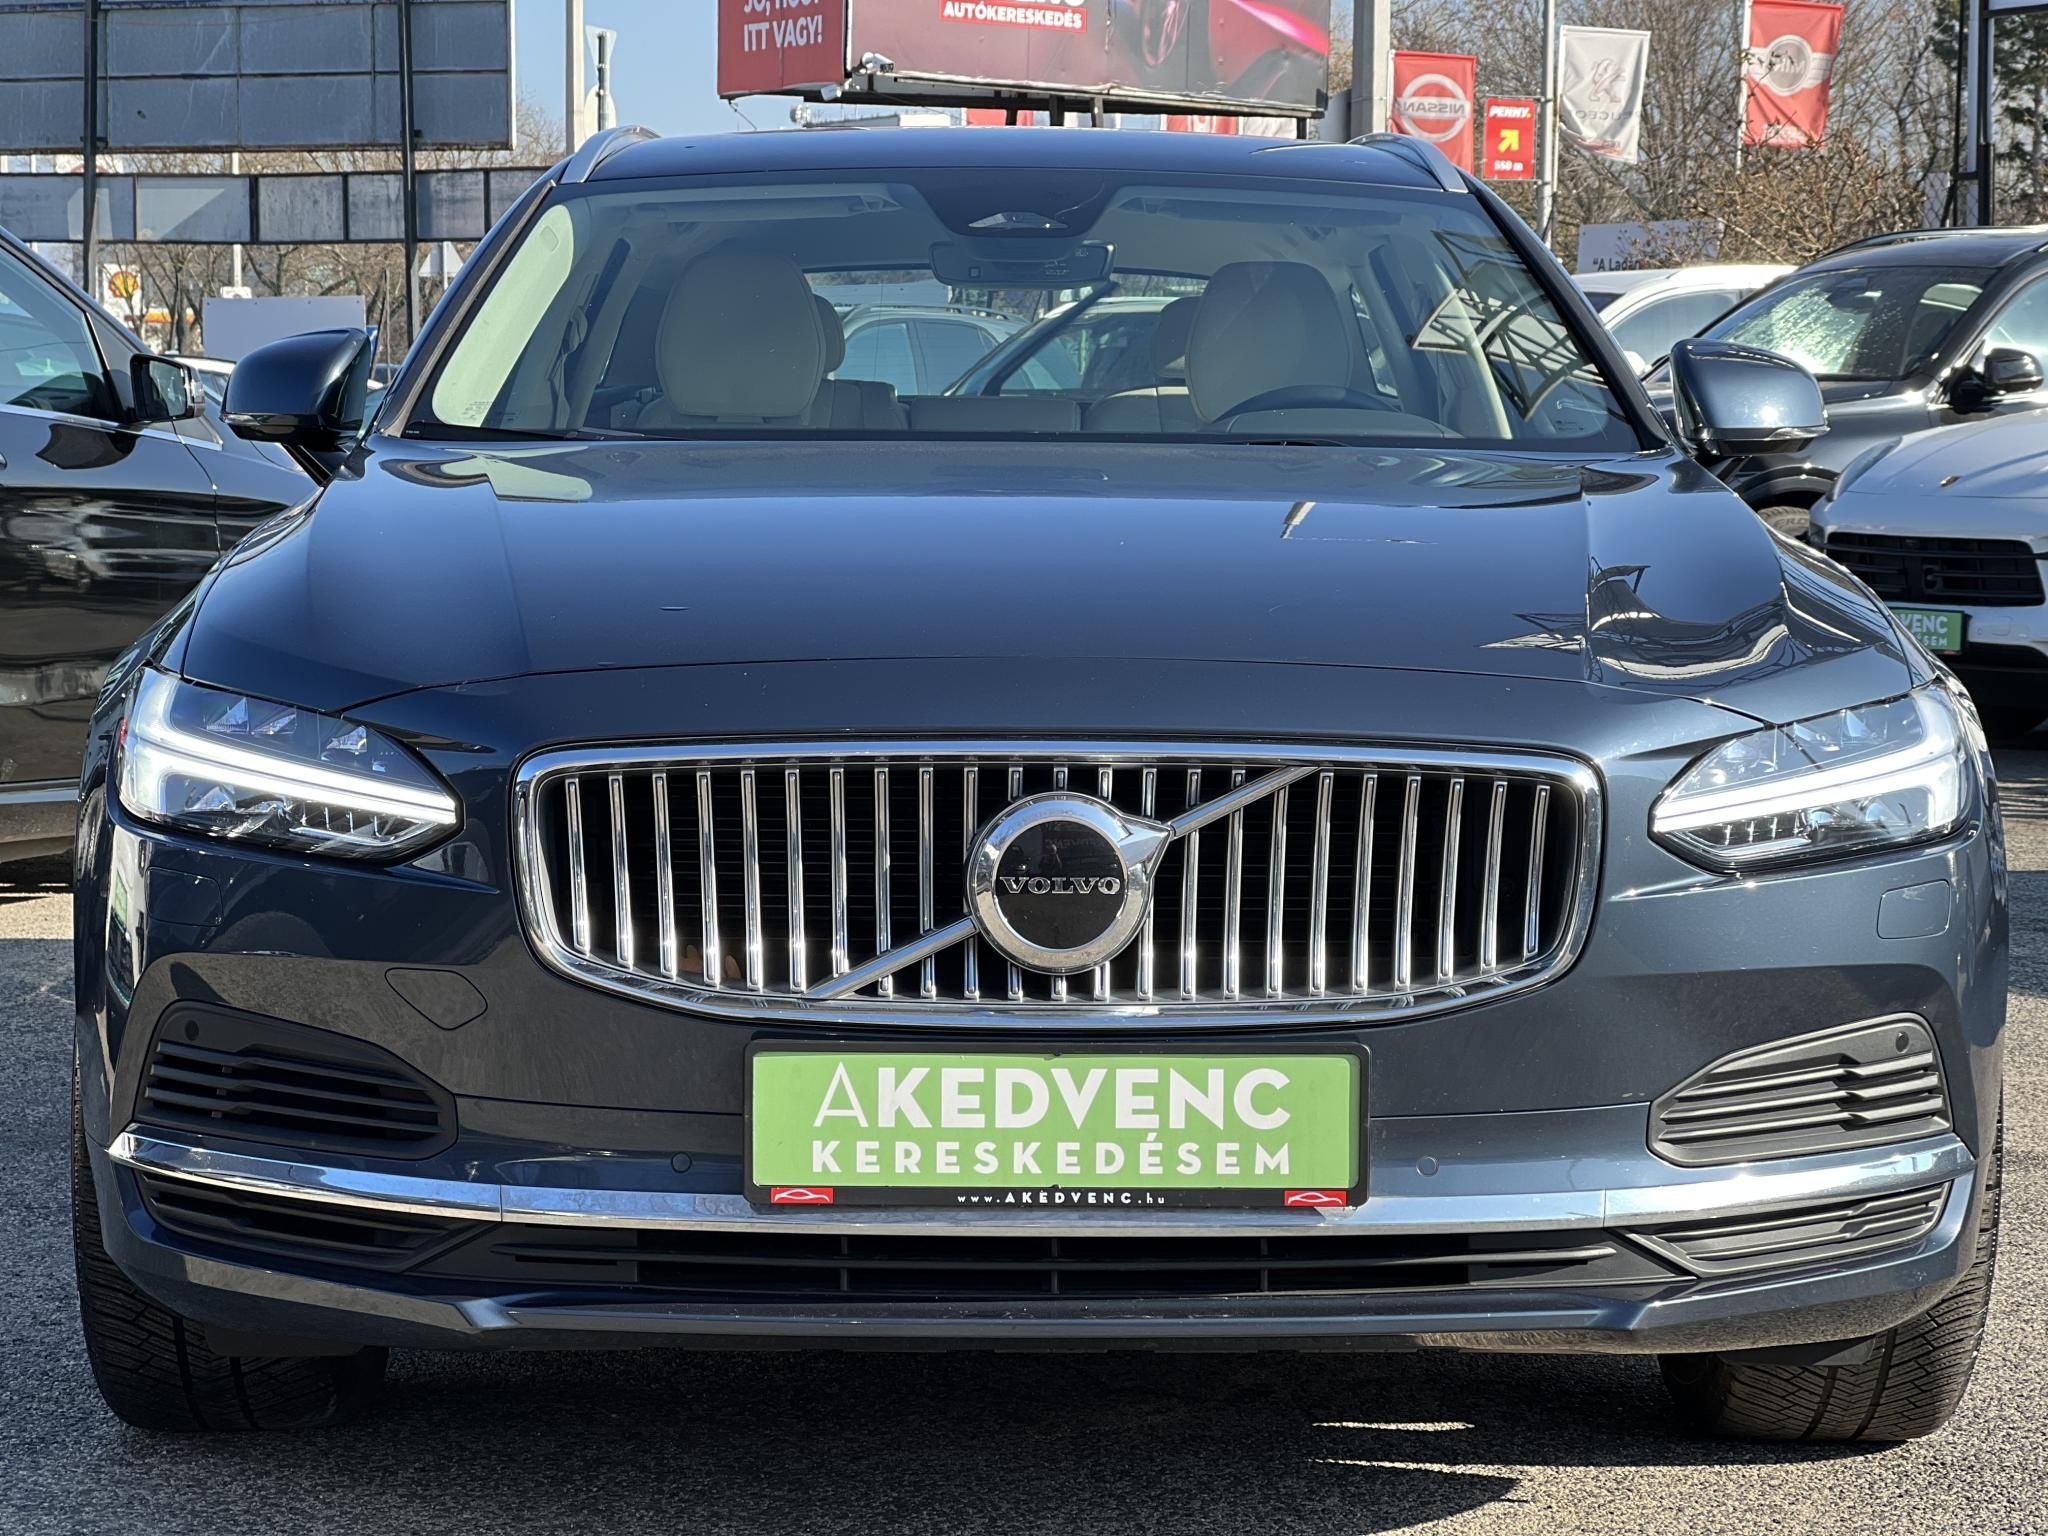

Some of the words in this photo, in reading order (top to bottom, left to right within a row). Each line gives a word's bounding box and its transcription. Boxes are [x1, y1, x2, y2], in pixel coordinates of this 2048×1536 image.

[943, 2, 1082, 28] AUTÓKERESKEDÉS
[744, 22, 769, 51] ITT
[773, 15, 822, 48] VAGY!
[1899, 614, 1948, 634] VENC
[999, 876, 1121, 895] VOLVO
[813, 1061, 1291, 1130] AKEDVENC
[812, 1132, 1290, 1175] KERESKEDÉSEM
[957, 1190, 1165, 1204] www.AKEDVENC.hu
